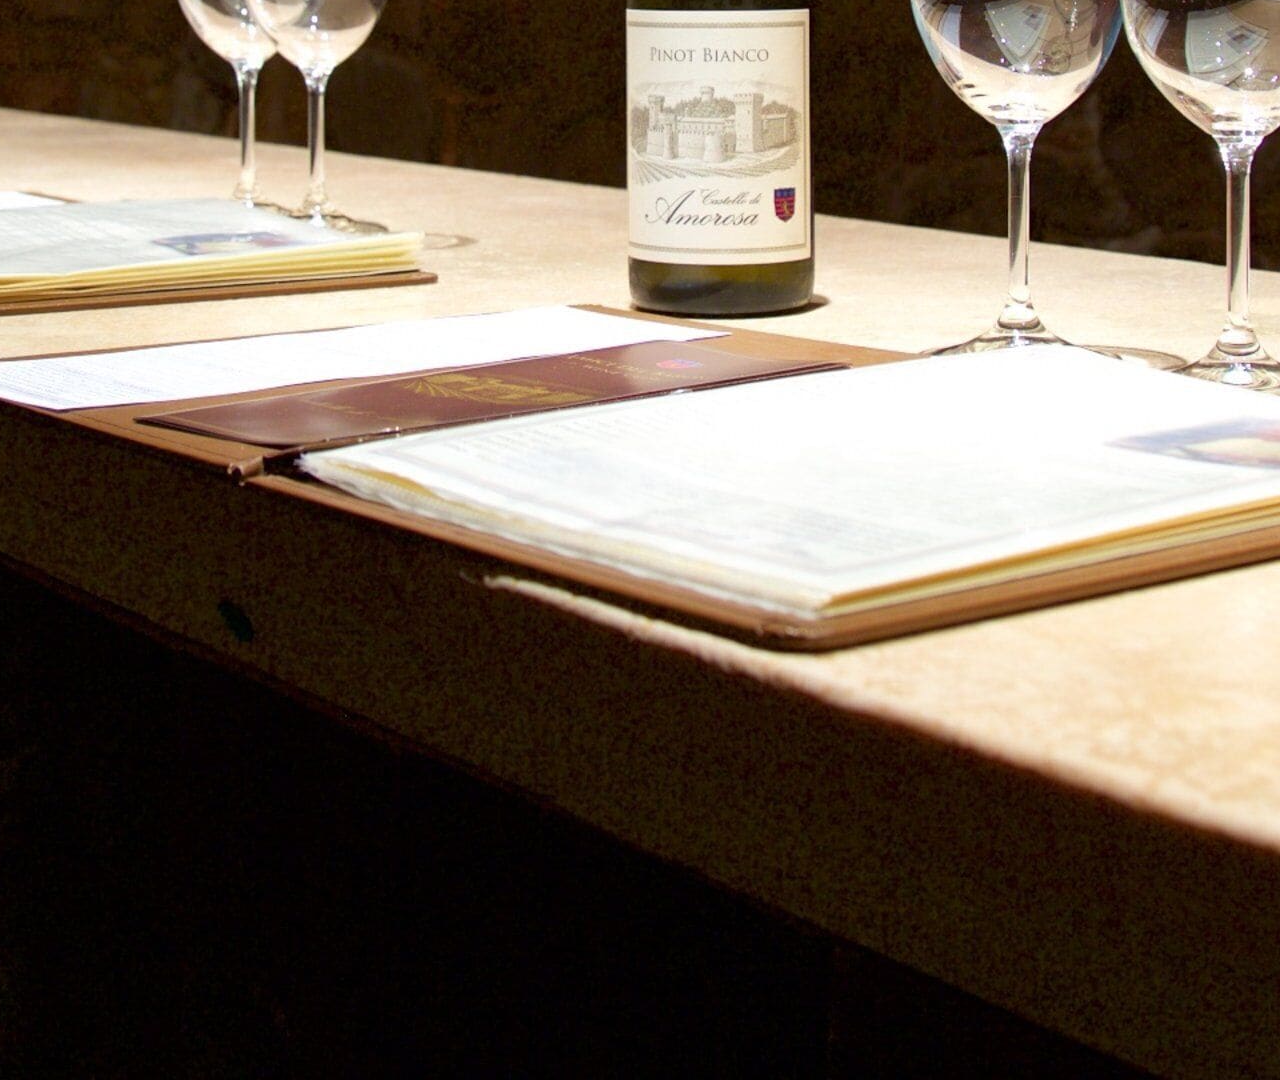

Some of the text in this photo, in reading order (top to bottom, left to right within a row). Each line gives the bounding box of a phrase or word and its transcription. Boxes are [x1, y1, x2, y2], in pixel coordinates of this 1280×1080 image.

[650, 46, 769, 63] PINOT BIANCO
[700, 188, 762, 206] Castello di
[645, 189, 759, 226] Amorosa
